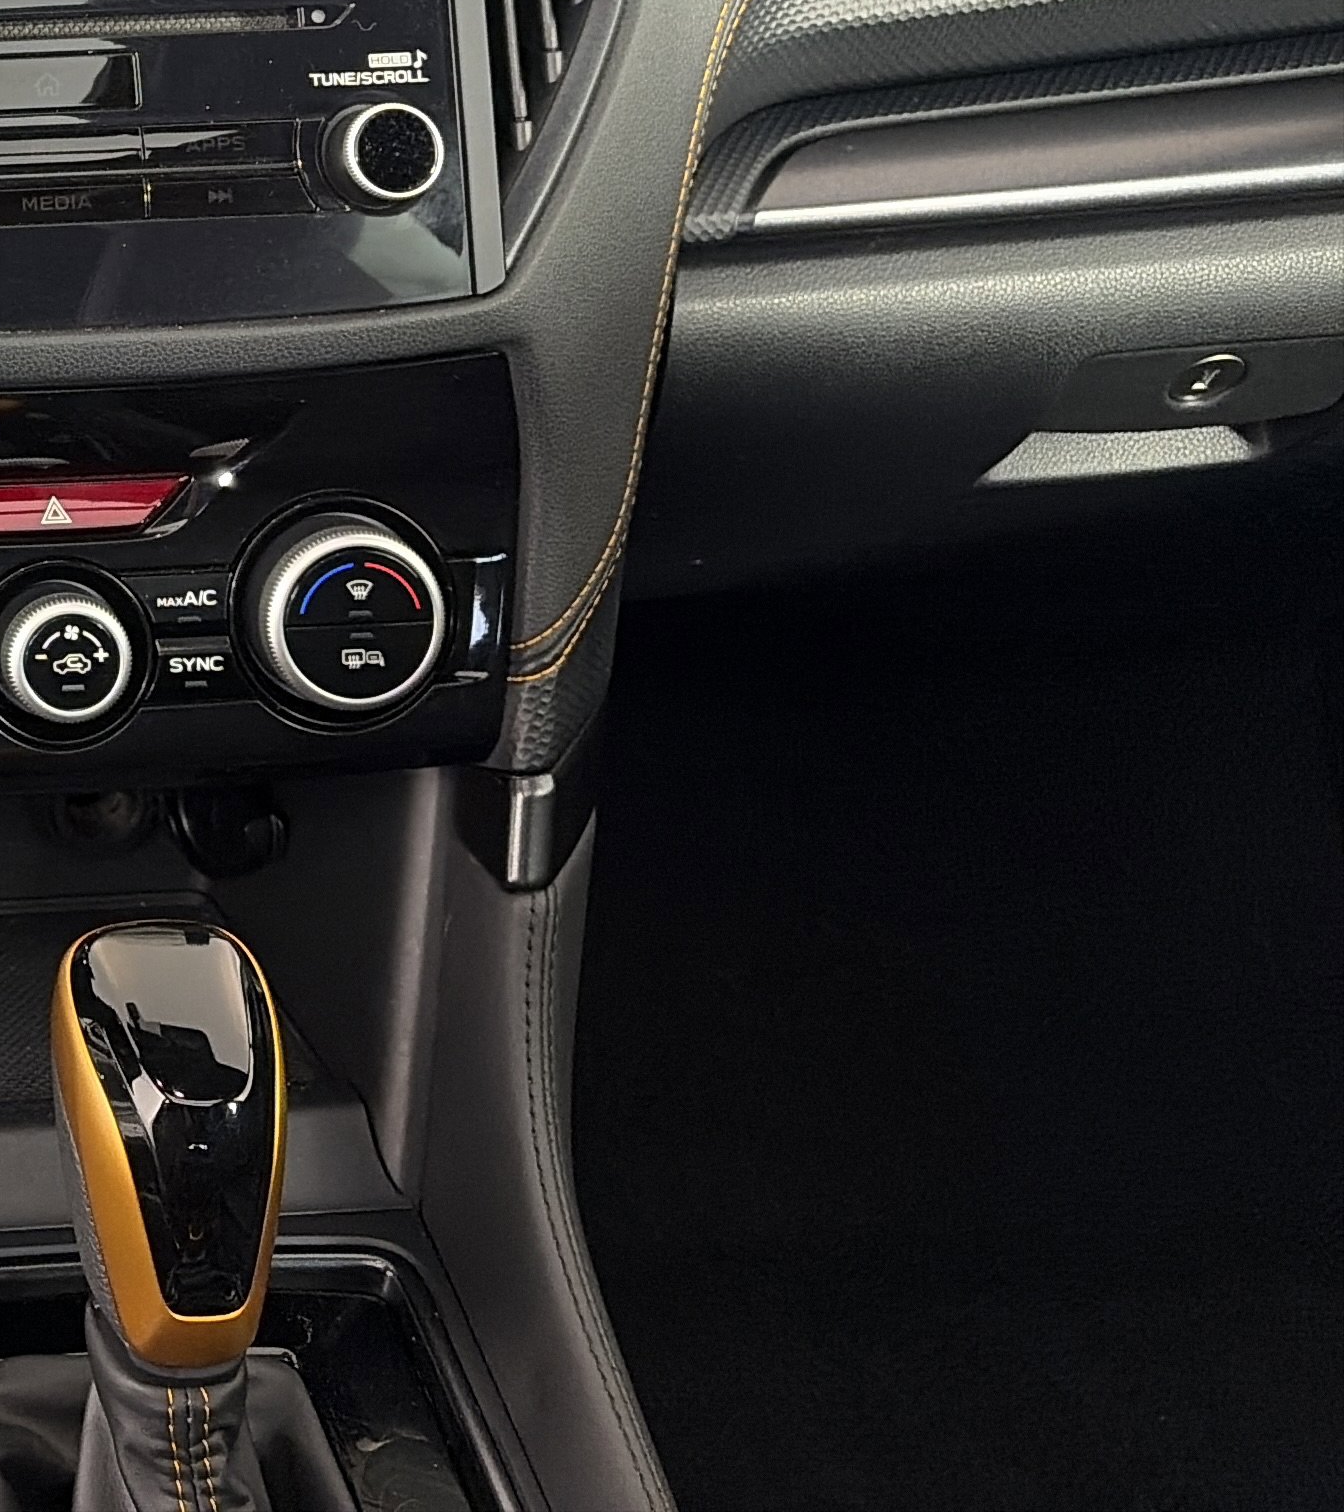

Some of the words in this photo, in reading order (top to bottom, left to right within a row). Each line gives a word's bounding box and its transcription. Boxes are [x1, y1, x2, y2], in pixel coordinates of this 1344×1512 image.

[309, 70, 430, 87] TUNE/SCROLL
[186, 136, 246, 153] APPS
[22, 195, 93, 211] MEDIA
[169, 656, 225, 674] SYNC
